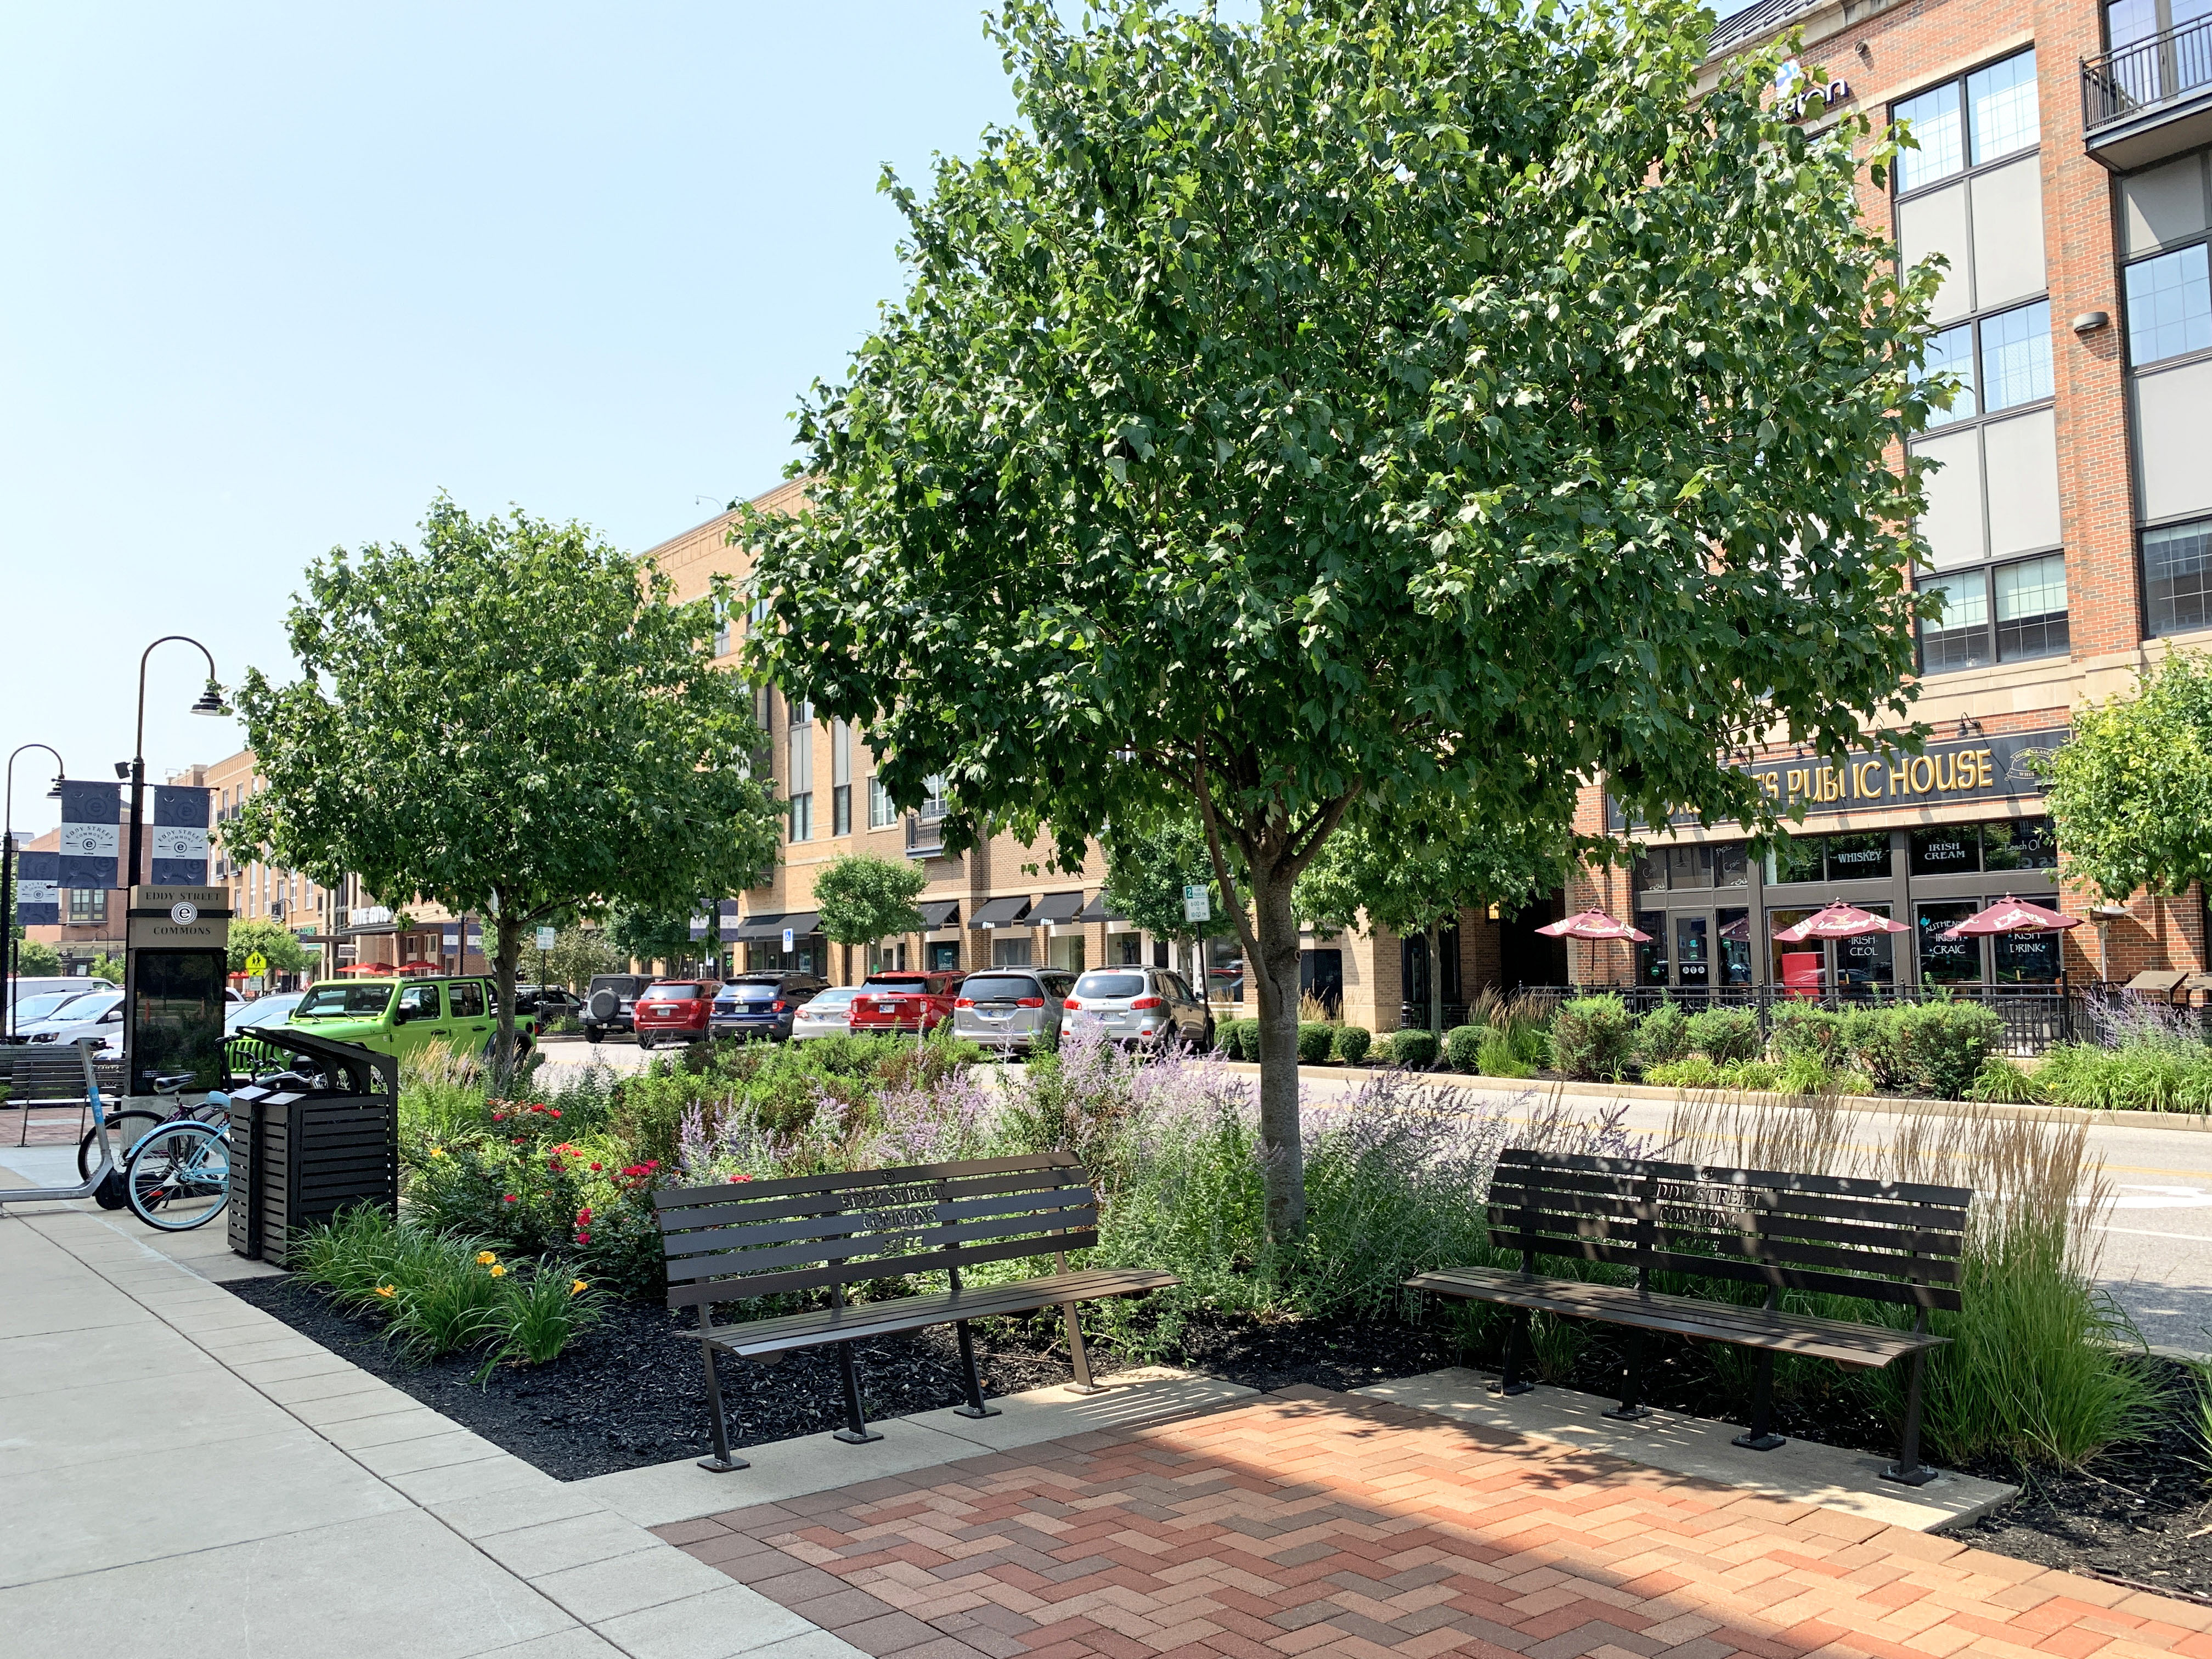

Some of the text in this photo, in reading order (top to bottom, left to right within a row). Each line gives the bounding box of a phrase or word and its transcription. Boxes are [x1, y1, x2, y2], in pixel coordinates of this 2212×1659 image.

[1787, 760, 1882, 805] PUBLIC
[1889, 748, 1993, 797] HOUSE
[65, 826, 114, 840] EDDY STREET
[158, 829, 204, 843] EDDY STREET
[1928, 842, 1960, 851] IRISH
[1838, 850, 1882, 864] WHISKEY
[1925, 851, 1965, 860] CREAM
[146, 891, 221, 901] EDDY STREET
[1187, 888, 1192, 898] 2
[352, 906, 391, 926] FIVE GUYS
[153, 926, 212, 935] COMMONS
[1850, 935, 1876, 945] IRISH
[1849, 947, 1878, 956] CEOL
[1933, 945, 1966, 954] CRAIC
[2010, 943, 2043, 953] DRINK
[840, 1183, 945, 1208] EDDY STREET
[1694, 1187, 1763, 1207] STREET
[863, 1206, 937, 1229] COMMONS
[1659, 1206, 1739, 1229] COMMONS
